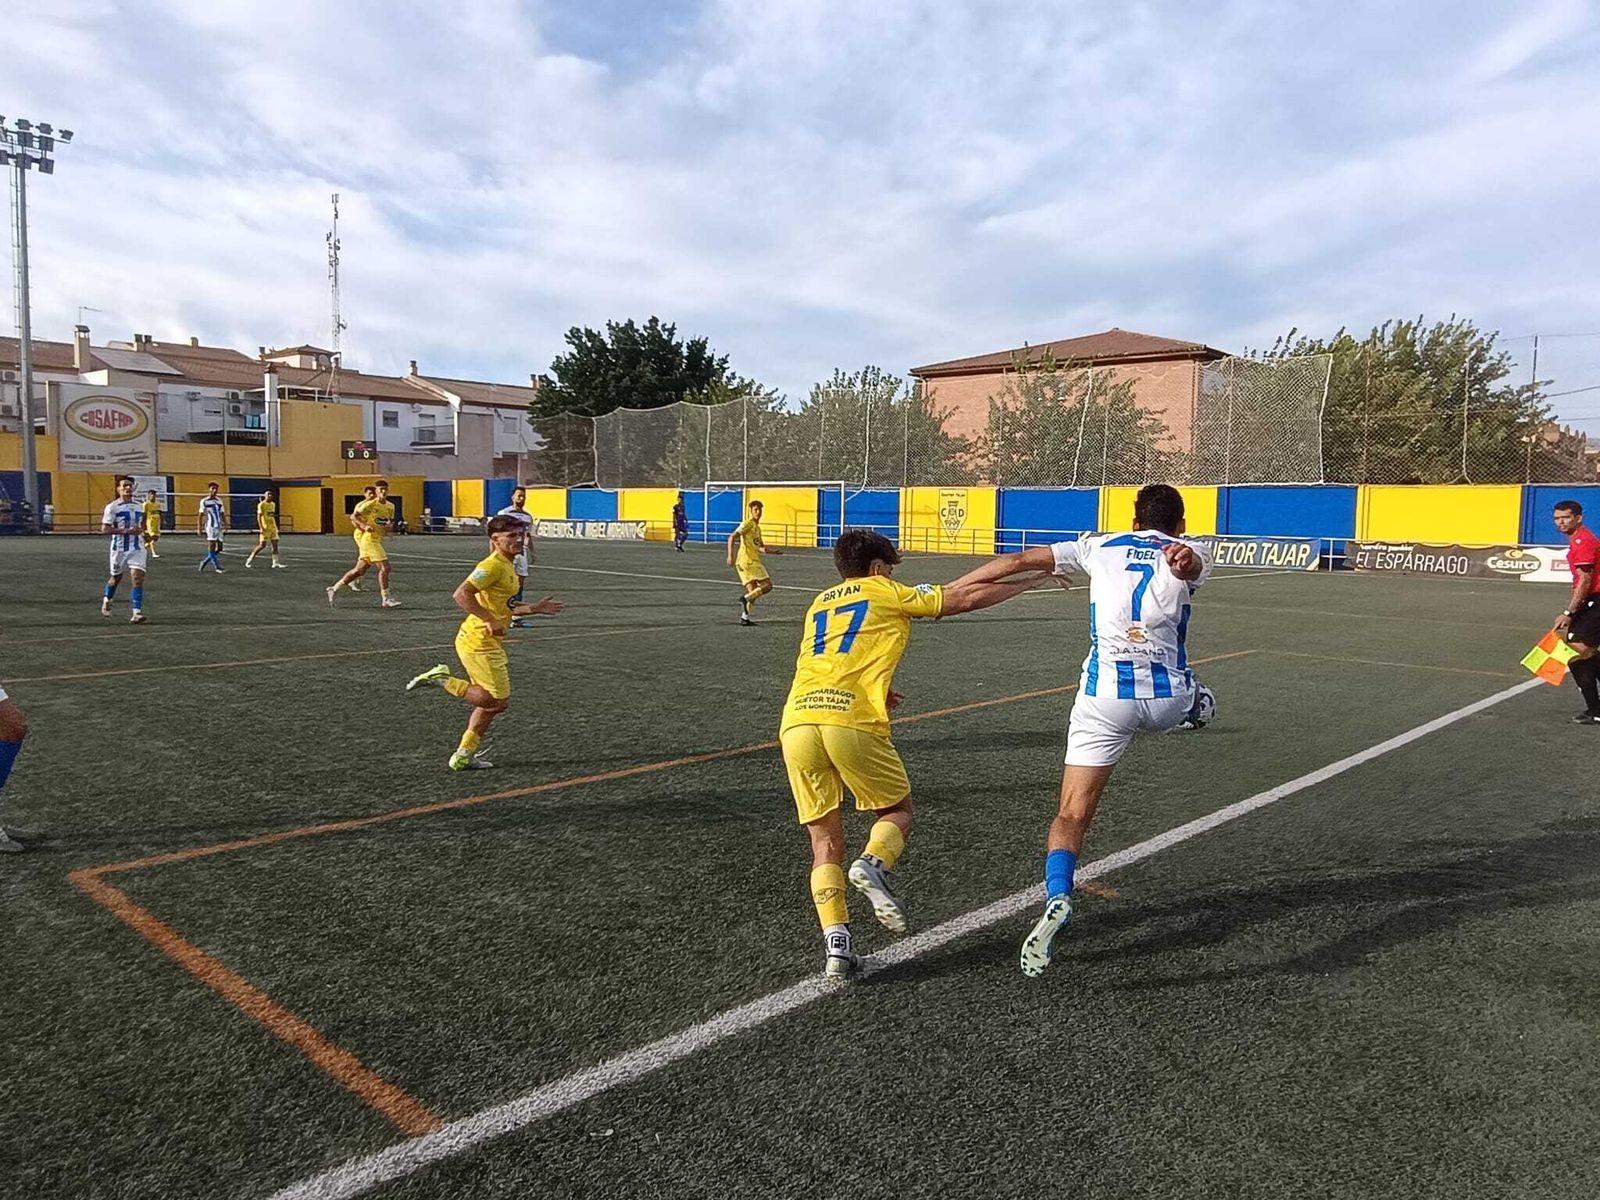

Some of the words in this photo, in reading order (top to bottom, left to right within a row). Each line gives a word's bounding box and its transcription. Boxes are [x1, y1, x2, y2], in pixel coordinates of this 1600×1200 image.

[80, 409, 134, 430] COSAFRA
[348, 450, 354, 458] 0
[363, 450, 369, 458] 0
[1126, 548, 1156, 560] FIDEL
[1205, 539, 1257, 565] UÉTOR
[1260, 543, 1311, 566] TAJAR
[1356, 552, 1372, 568] EL
[1375, 551, 1468, 575] ESPÁRRAGO
[1487, 556, 1539, 570] Cesurca
[823, 585, 861, 602] BRYAN
[1125, 563, 1155, 622] 7
[813, 600, 869, 655] 17
